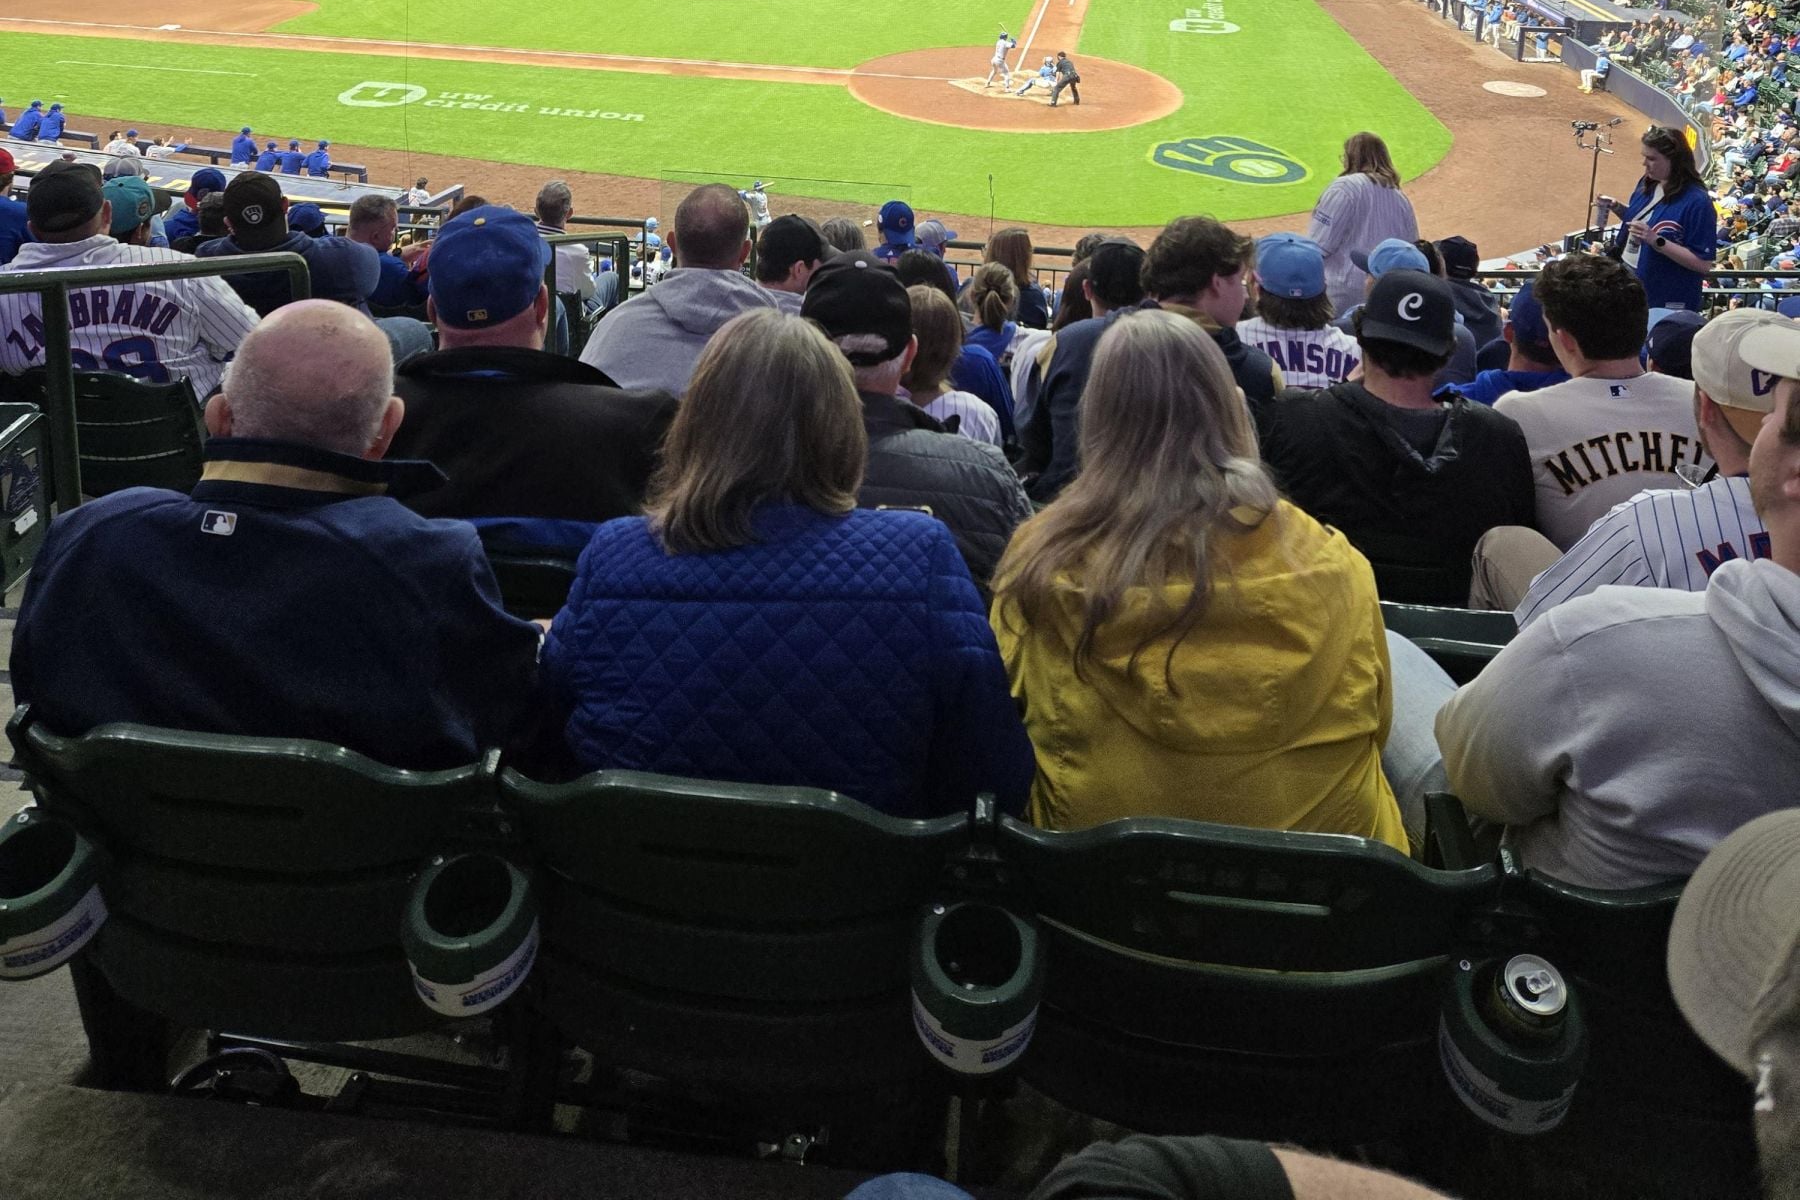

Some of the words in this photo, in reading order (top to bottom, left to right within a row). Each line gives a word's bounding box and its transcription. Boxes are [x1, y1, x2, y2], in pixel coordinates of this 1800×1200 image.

[423, 99, 531, 113] credit
[538, 106, 646, 123] union
[438, 91, 493, 101] uw
[5, 289, 181, 362] ZABRANO
[1257, 340, 1360, 382] ANSON
[1544, 430, 1704, 497] MITCHE
